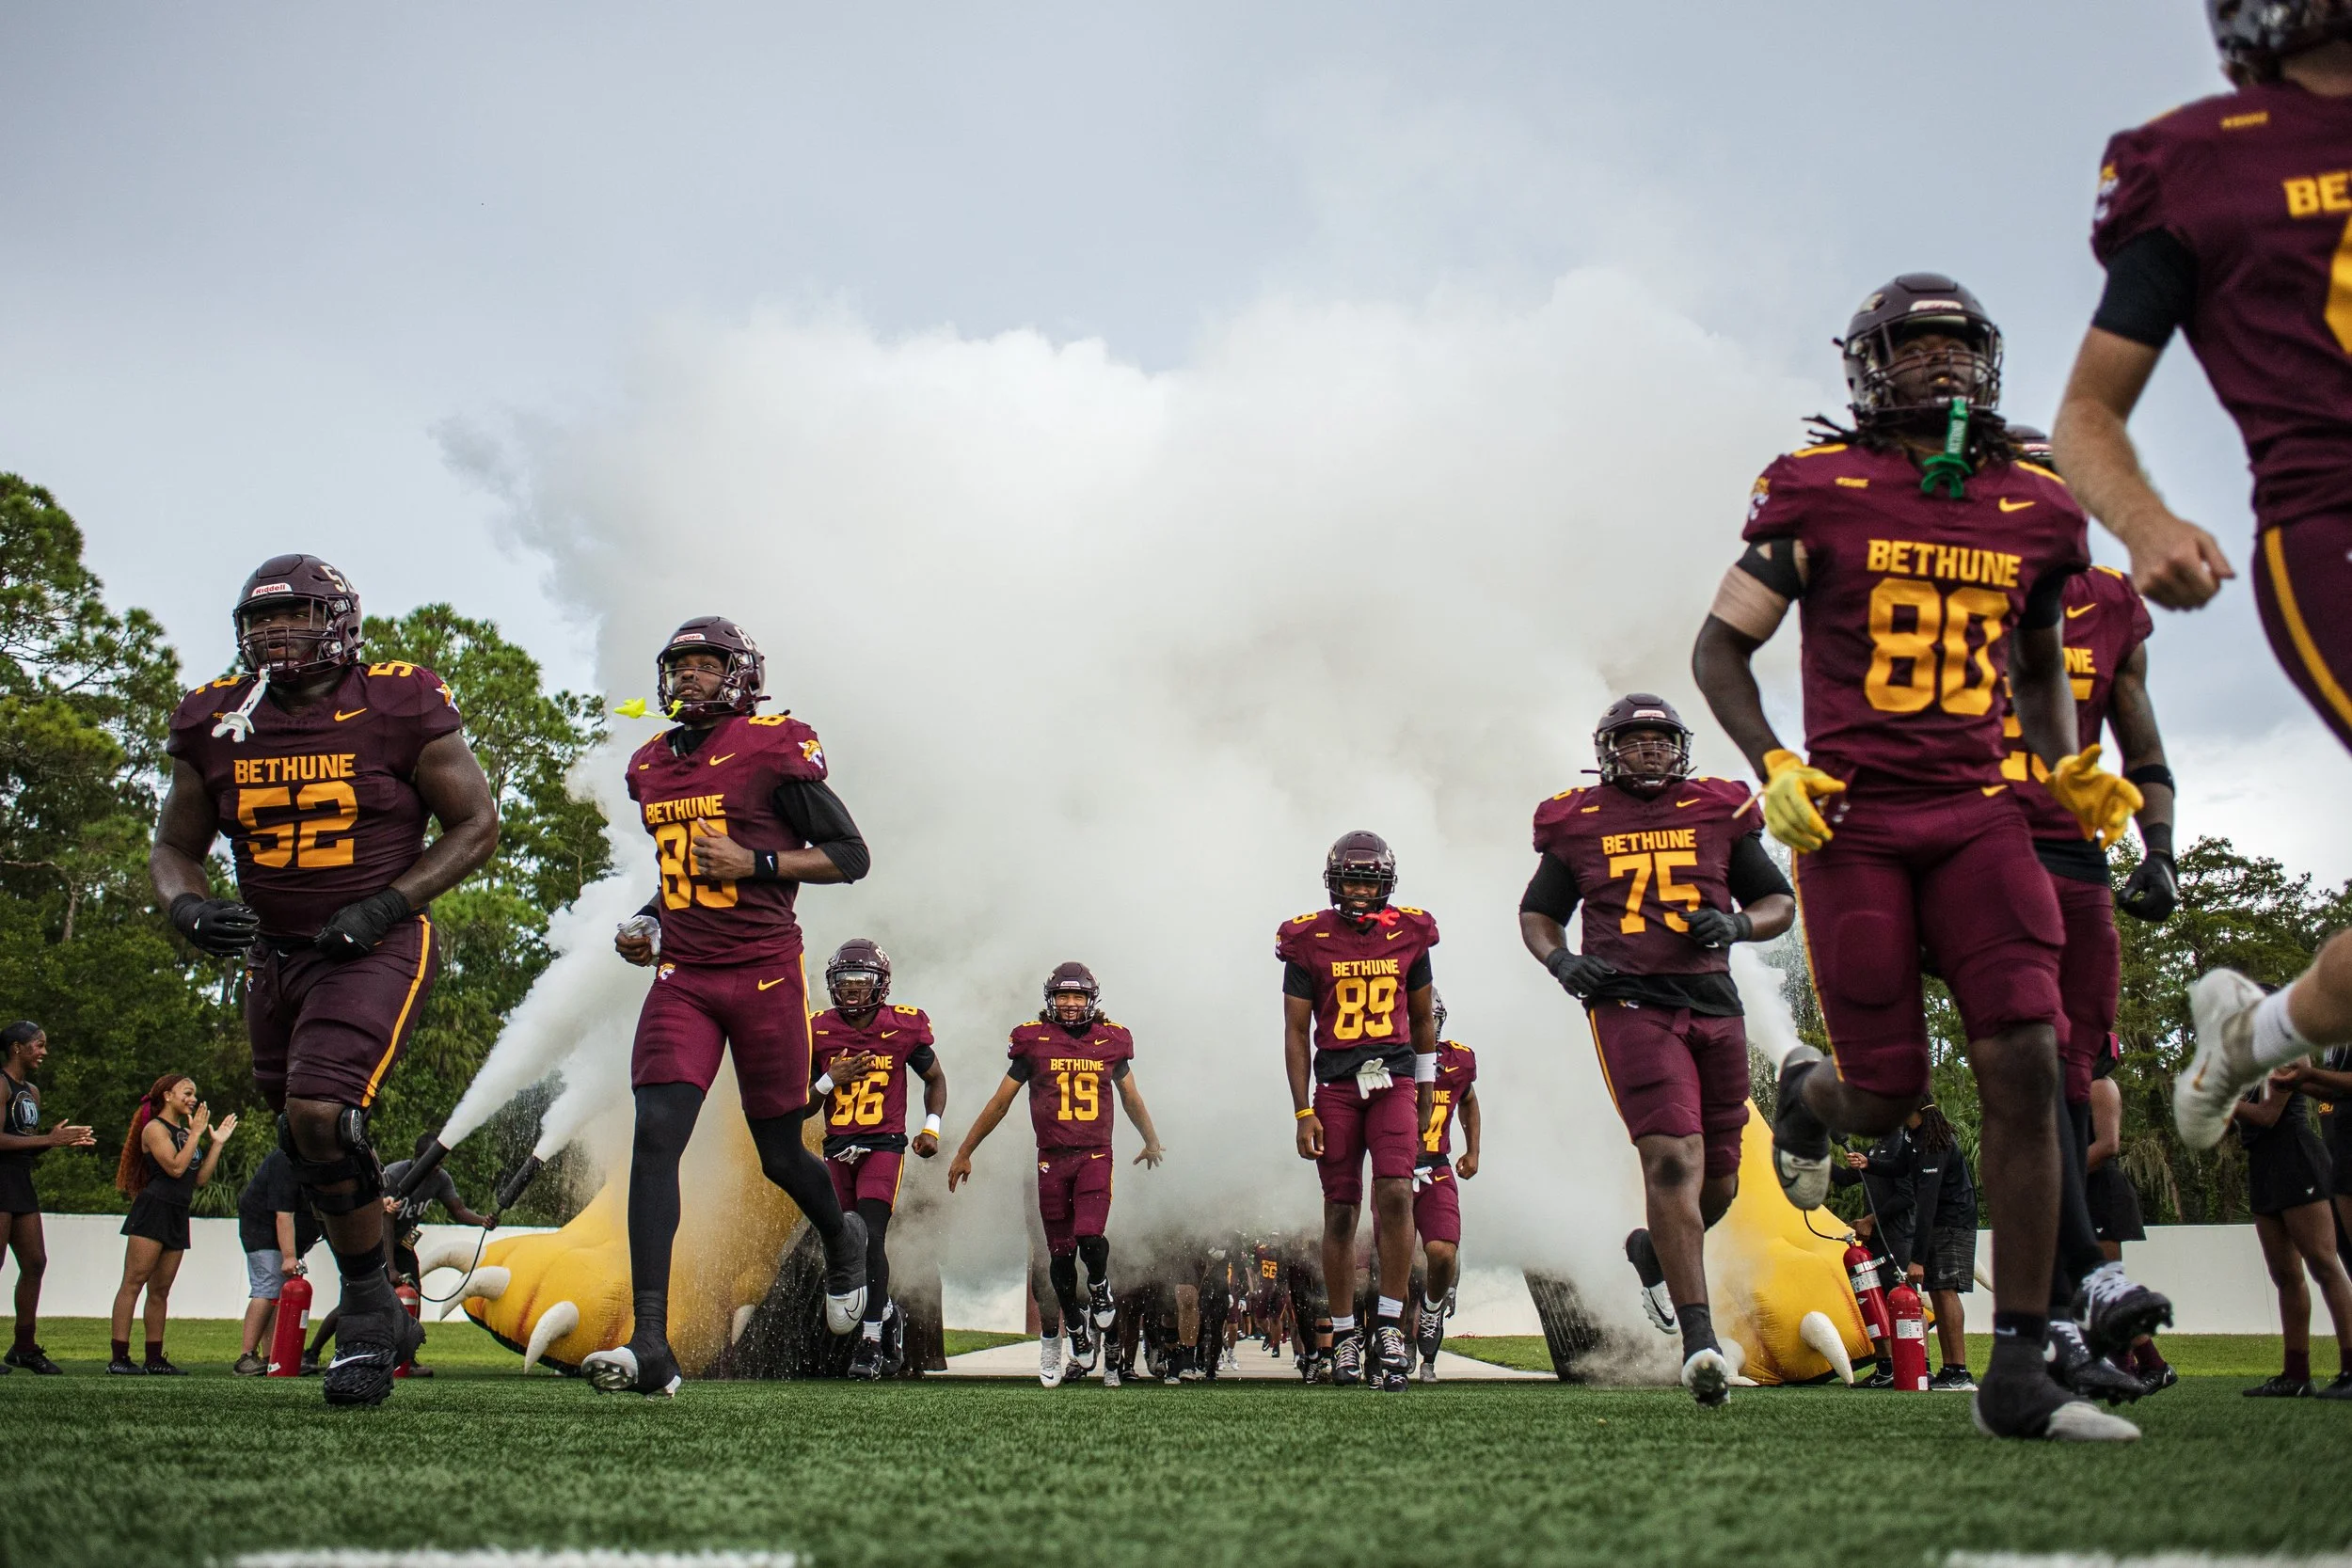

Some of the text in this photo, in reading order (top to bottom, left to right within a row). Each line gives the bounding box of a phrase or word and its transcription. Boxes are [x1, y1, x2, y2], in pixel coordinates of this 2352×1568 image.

[1867, 539, 2021, 588] BETHUNE
[255, 584, 286, 594] Riddell
[1865, 578, 2010, 717] 80
[233, 753, 356, 784] BETHUNE
[238, 781, 358, 868] 52
[646, 794, 727, 824] BETHUNE
[656, 818, 739, 911] 85
[1601, 829, 1697, 855] BETHUNE
[1609, 850, 1701, 935] 75
[1331, 958, 1400, 977] BETHUNE
[1333, 976, 1398, 1039] 89
[1050, 1059, 1104, 1070] BETHUNE
[830, 1071, 890, 1126] 86
[1057, 1072, 1099, 1121] 19
[1422, 1105, 1448, 1152] 4
